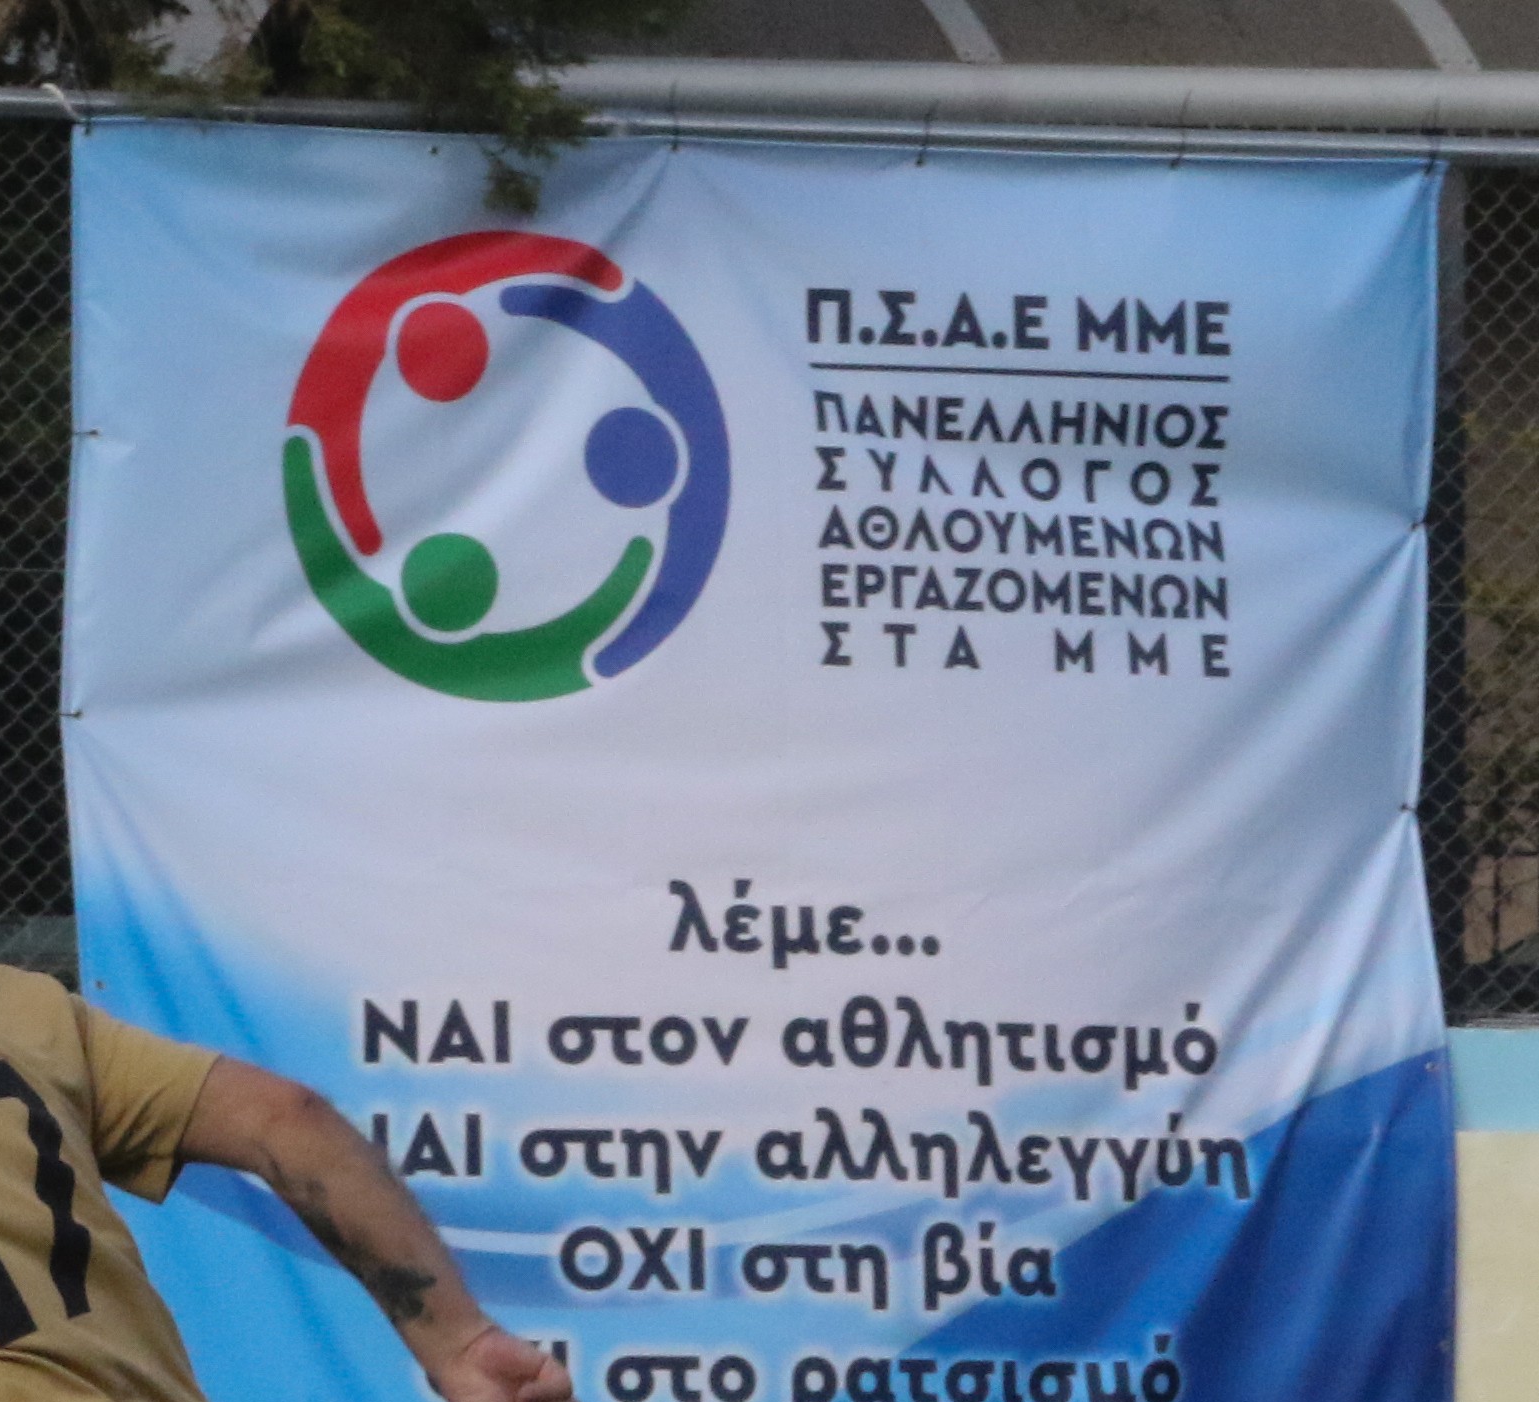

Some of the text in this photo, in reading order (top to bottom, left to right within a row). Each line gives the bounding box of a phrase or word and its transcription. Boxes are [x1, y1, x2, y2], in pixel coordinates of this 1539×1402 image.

[807, 288, 1231, 356] Π.Σ.Α.Ε ΜΜΕ
[814, 390, 1229, 450] ΠΑΝΕΛΛΗΝΙΟΣ
[816, 447, 1220, 507] ΣΥΛΛΟΓΟΣ
[819, 505, 1225, 562] ΑΘΛΟΥΜΕΝΩΝ
[821, 563, 1229, 620] ΕΡΓΑΖΟΜΕΝΩΝ
[821, 622, 1230, 677] ΣΤΑ ΜΜΕ
[669, 879, 940, 969] λέμε...
[362, 995, 1219, 1089] ΝΑΙ στον αθλητισμό
[520, 1129, 722, 1194] στην
[756, 1107, 1252, 1200] αλληλεγγύη
[559, 1221, 1057, 1311] ΟΧΙ στη βία
